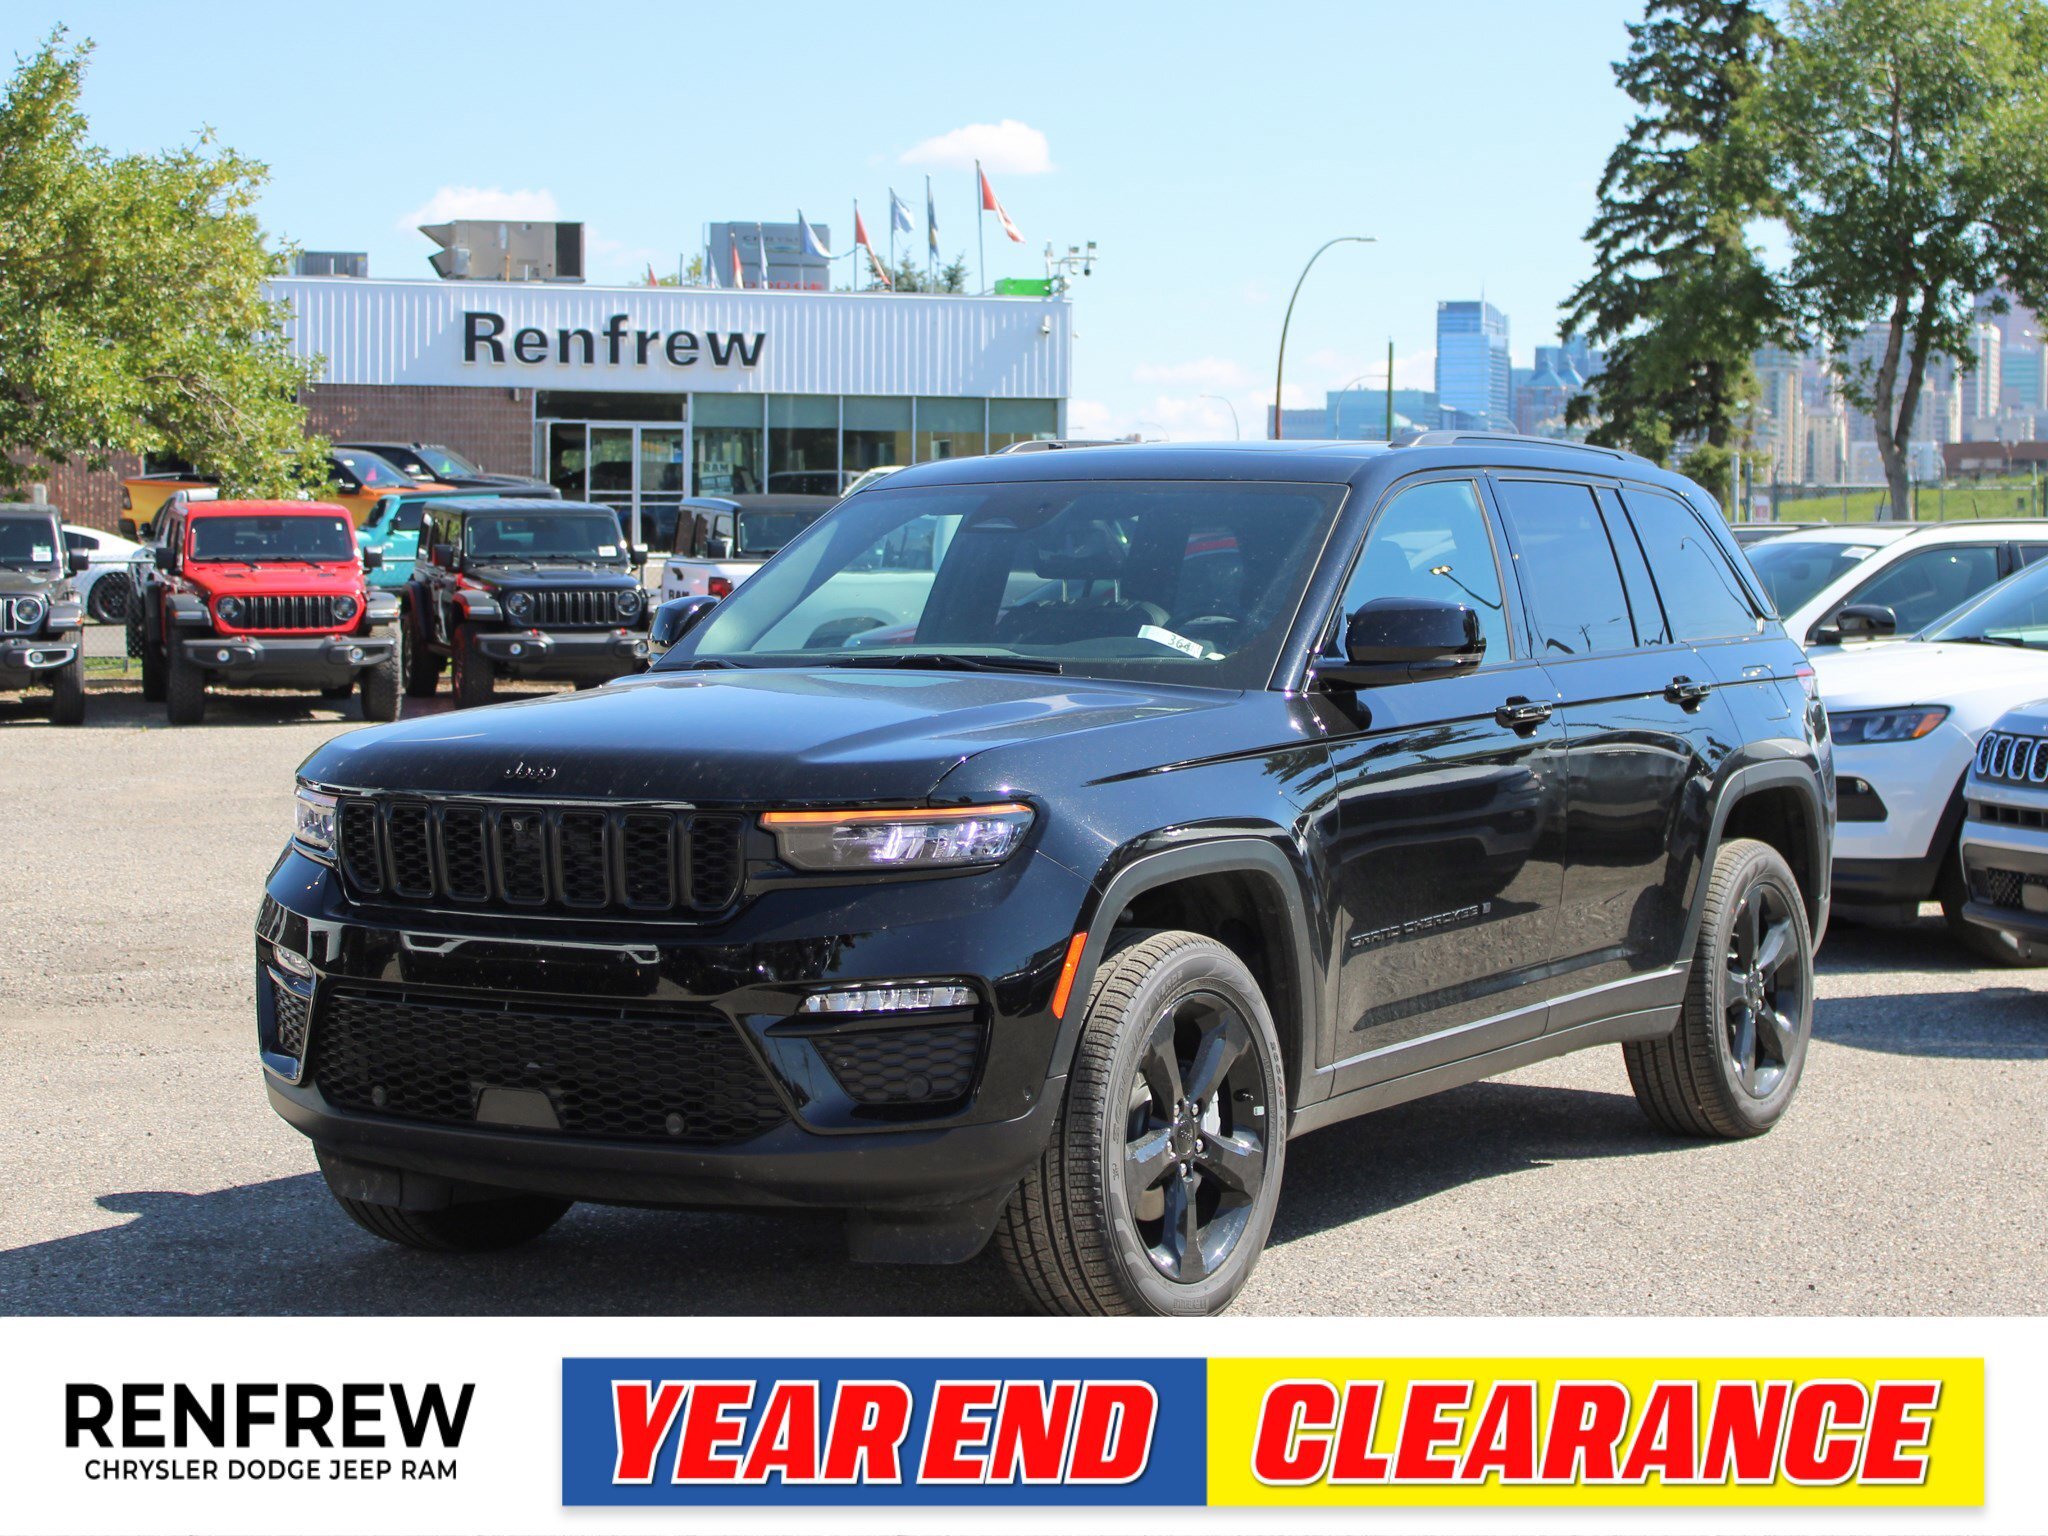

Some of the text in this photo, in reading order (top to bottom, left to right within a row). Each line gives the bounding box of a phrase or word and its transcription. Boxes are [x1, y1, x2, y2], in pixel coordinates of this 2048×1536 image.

[464, 311, 766, 367] Renfrew
[702, 463, 730, 474] RAM
[1167, 633, 1192, 653] 364
[503, 761, 557, 783] Jeep
[1403, 904, 1480, 934] CHEROKEE
